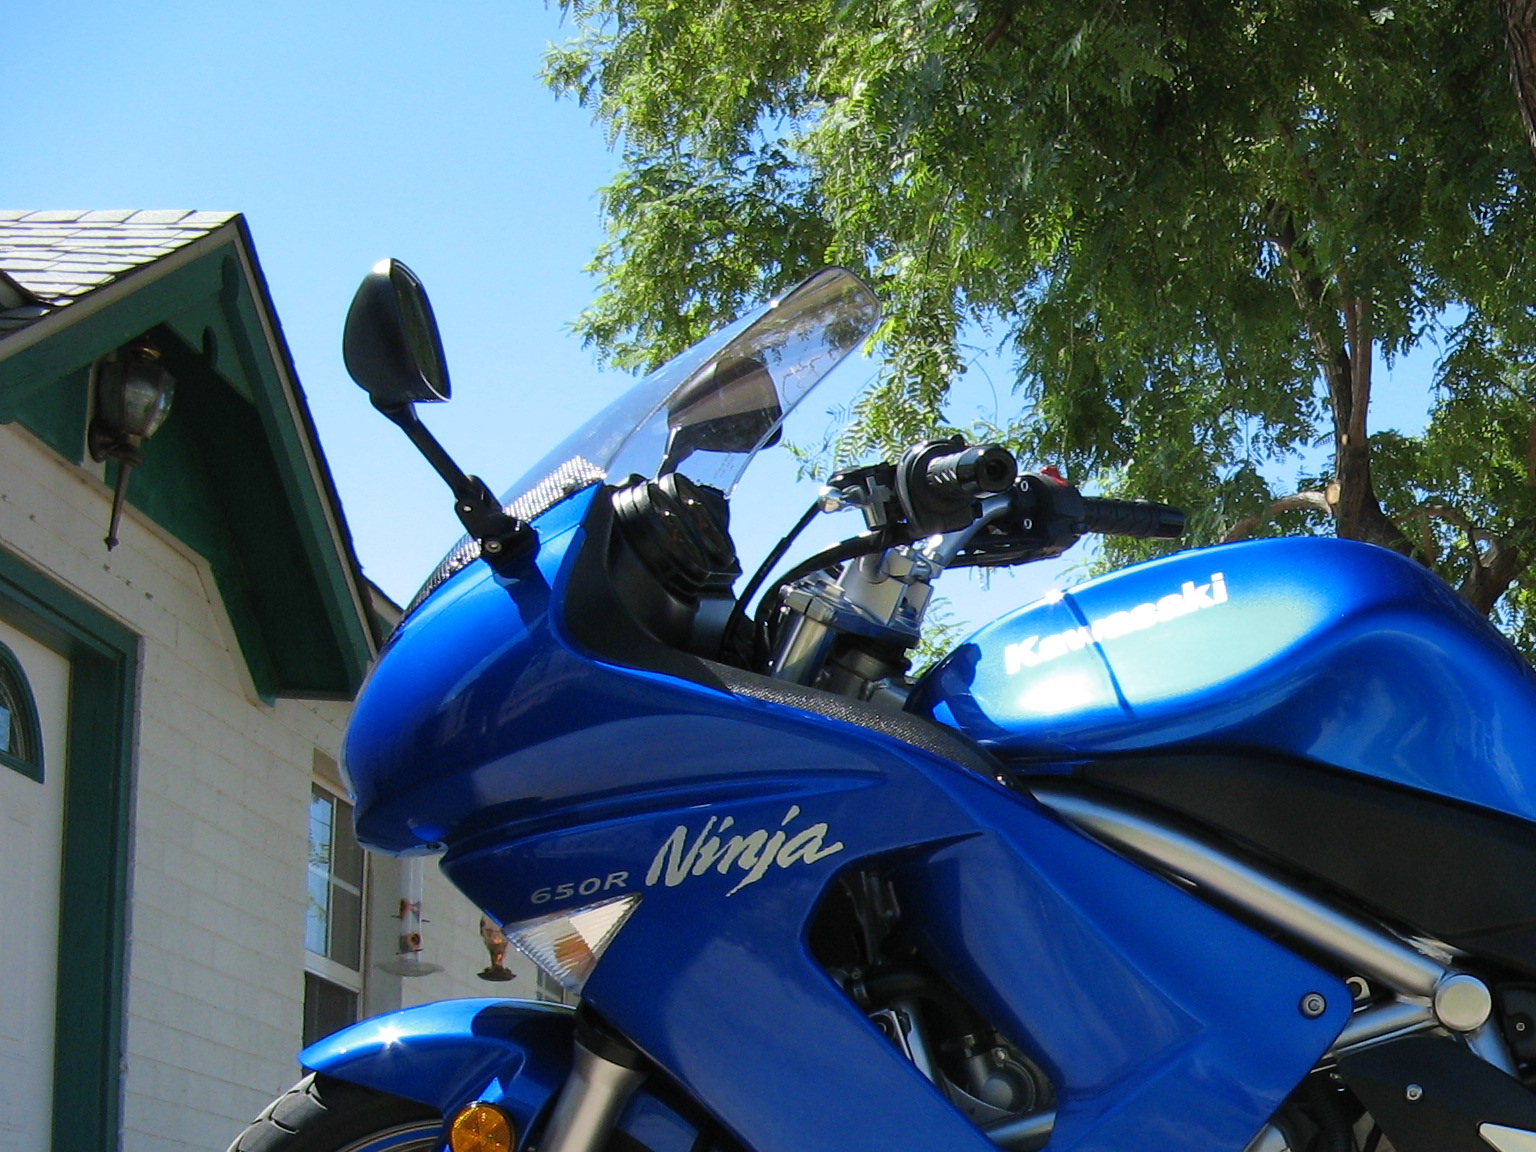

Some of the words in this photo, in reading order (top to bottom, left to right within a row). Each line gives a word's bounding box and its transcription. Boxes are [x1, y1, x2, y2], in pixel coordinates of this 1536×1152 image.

[1004, 572, 1229, 675] Kawasaki
[530, 870, 630, 905] 650R
[644, 804, 845, 897] Ninja
